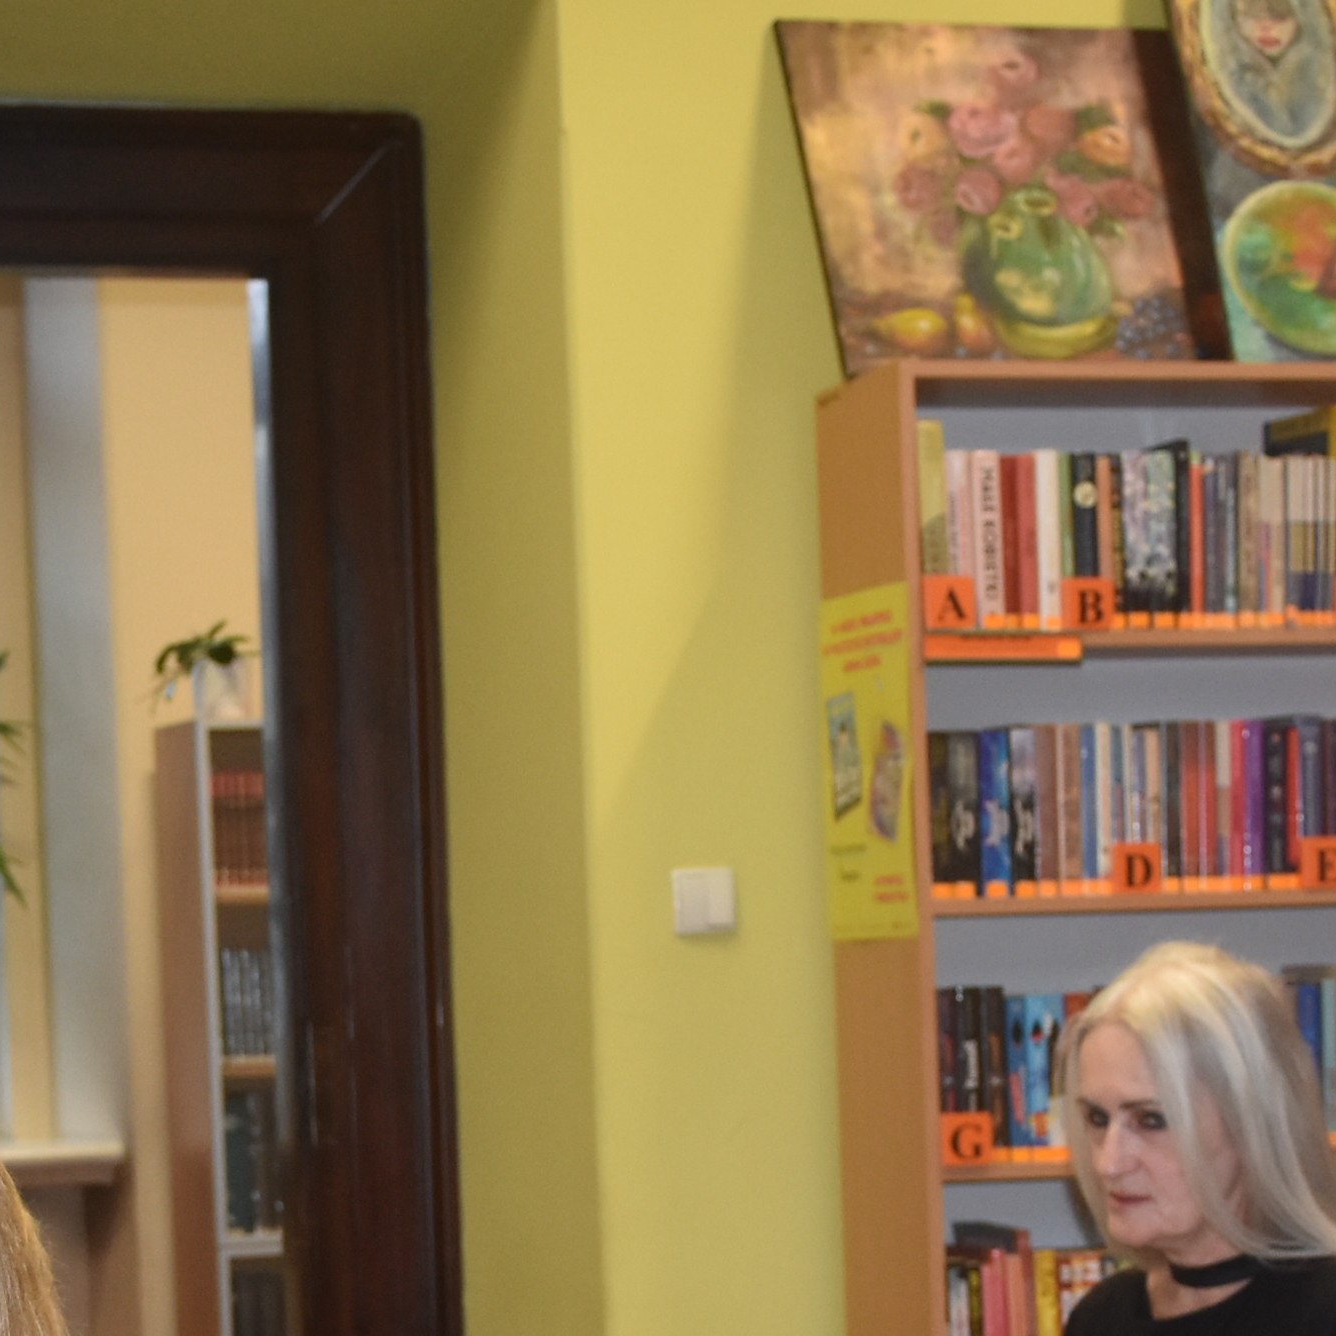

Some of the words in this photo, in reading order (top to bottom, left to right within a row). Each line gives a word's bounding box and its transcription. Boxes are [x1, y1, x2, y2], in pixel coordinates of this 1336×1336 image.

[935, 585, 966, 621] A
[1076, 588, 1105, 625] B
[1124, 853, 1153, 888] D
[950, 1126, 982, 1161] G
